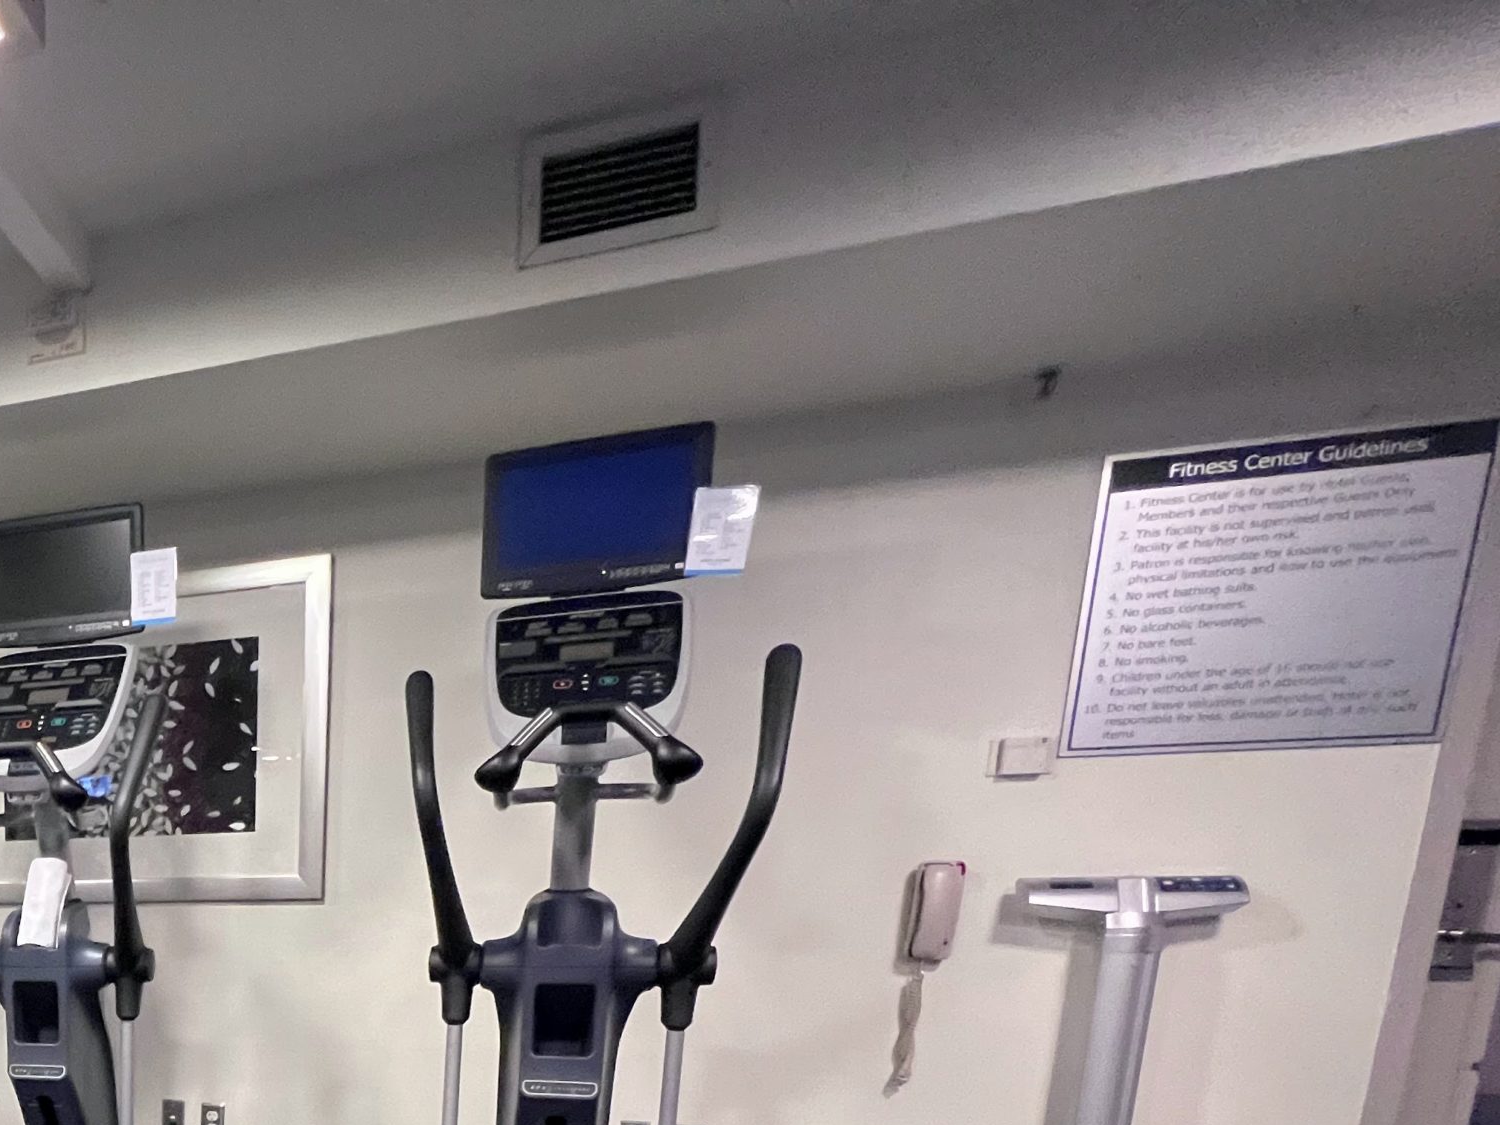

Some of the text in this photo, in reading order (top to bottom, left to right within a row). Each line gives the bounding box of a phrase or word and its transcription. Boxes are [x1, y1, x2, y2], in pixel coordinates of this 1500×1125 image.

[1169, 437, 1430, 478] Fitness Center Guidelines
[1140, 495, 1185, 508] Fitness
[1189, 491, 1230, 503] Center
[1250, 486, 1266, 497] for
[1137, 508, 1195, 522] Members
[1200, 504, 1224, 516] and
[1228, 502, 1257, 514] their
[1136, 528, 1161, 539] This
[1165, 524, 1205, 536] facility
[1224, 520, 1244, 530] not
[1323, 510, 1350, 522] and
[1133, 542, 1172, 554] facility
[1130, 558, 1170, 570] Patron
[1188, 551, 1261, 566] responsible
[1128, 571, 1177, 586] physical
[1182, 566, 1245, 579] limitations
[1251, 562, 1275, 575] and
[1125, 591, 1142, 601] No
[1146, 588, 1169, 599] wet
[1173, 583, 1220, 597] bathing
[1123, 608, 1140, 617] No
[1143, 604, 1174, 618] glass
[1120, 624, 1137, 634] No
[1141, 619, 1193, 633] alcoholic
[1118, 641, 1134, 650] No
[1138, 637, 1165, 649] bare
[1114, 657, 1132, 666] No
[1111, 672, 1162, 683] Children
[1165, 669, 1202, 680] under
[1109, 685, 1148, 697] facility
[1152, 682, 1198, 694] without
[1222, 679, 1254, 690] adult
[1107, 703, 1124, 713] Do
[1127, 702, 1147, 712] not
[1104, 714, 1172, 726] responsible
[1177, 712, 1194, 723] for
